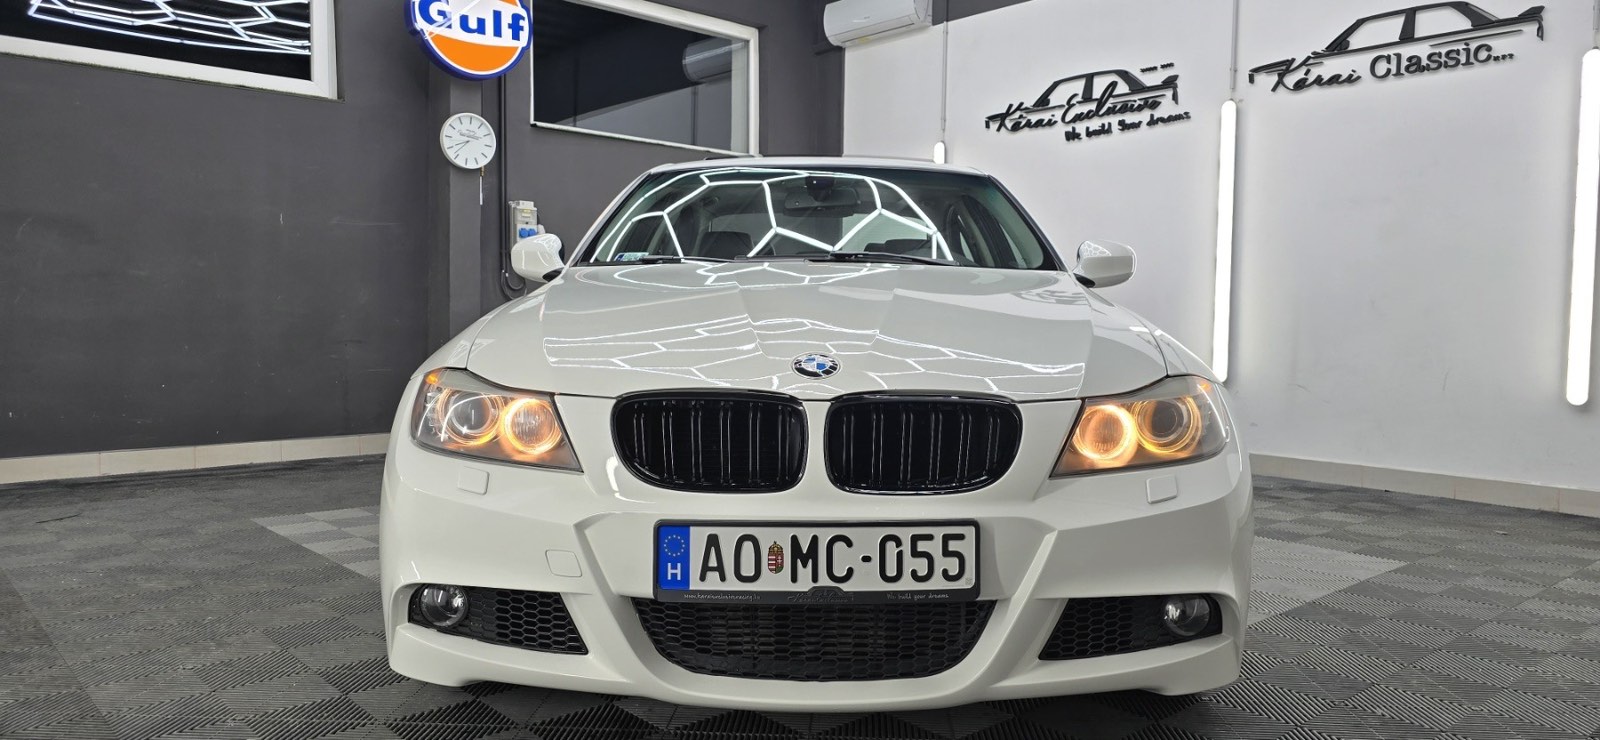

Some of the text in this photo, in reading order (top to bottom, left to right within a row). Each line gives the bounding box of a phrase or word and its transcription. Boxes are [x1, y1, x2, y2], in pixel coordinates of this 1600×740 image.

[418, 0, 525, 41] Gulf
[1369, 42, 1493, 80] Classic
[1061, 81, 1162, 124] Exclusive
[1086, 122, 1113, 138] build
[1147, 112, 1191, 126] dreams
[667, 562, 682, 581] H
[928, 592, 949, 600] dreams
